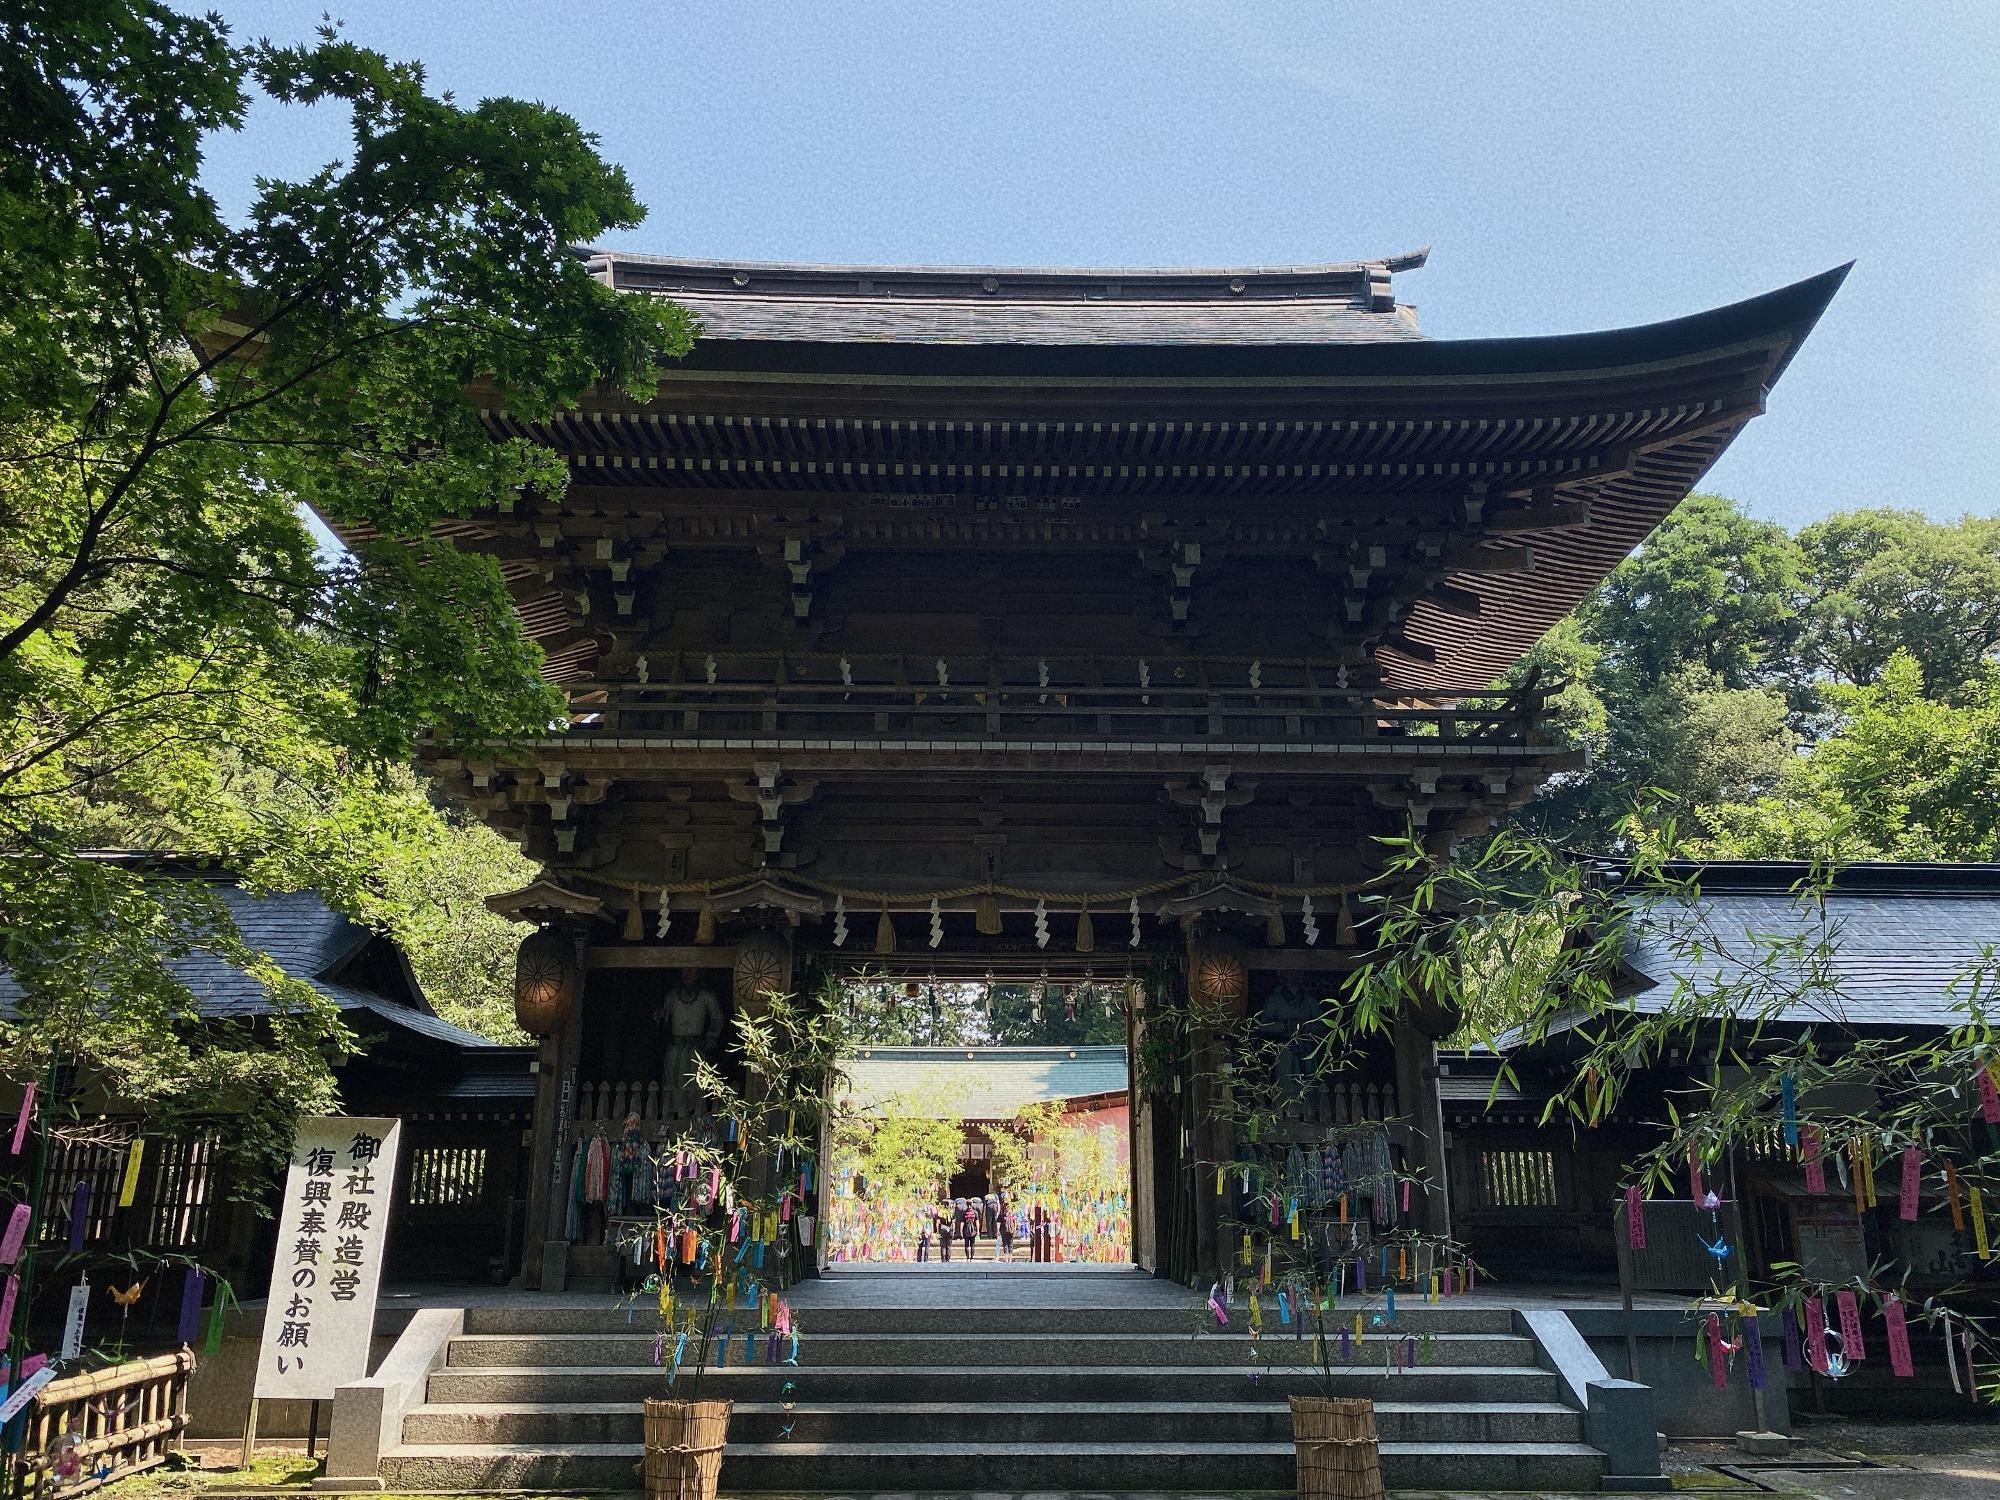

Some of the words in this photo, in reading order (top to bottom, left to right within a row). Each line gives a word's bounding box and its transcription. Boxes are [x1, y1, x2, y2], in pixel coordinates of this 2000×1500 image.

[276, 1146, 337, 1376] 復興奉賛のお願い
[329, 1132, 381, 1302] 御社殿造営
